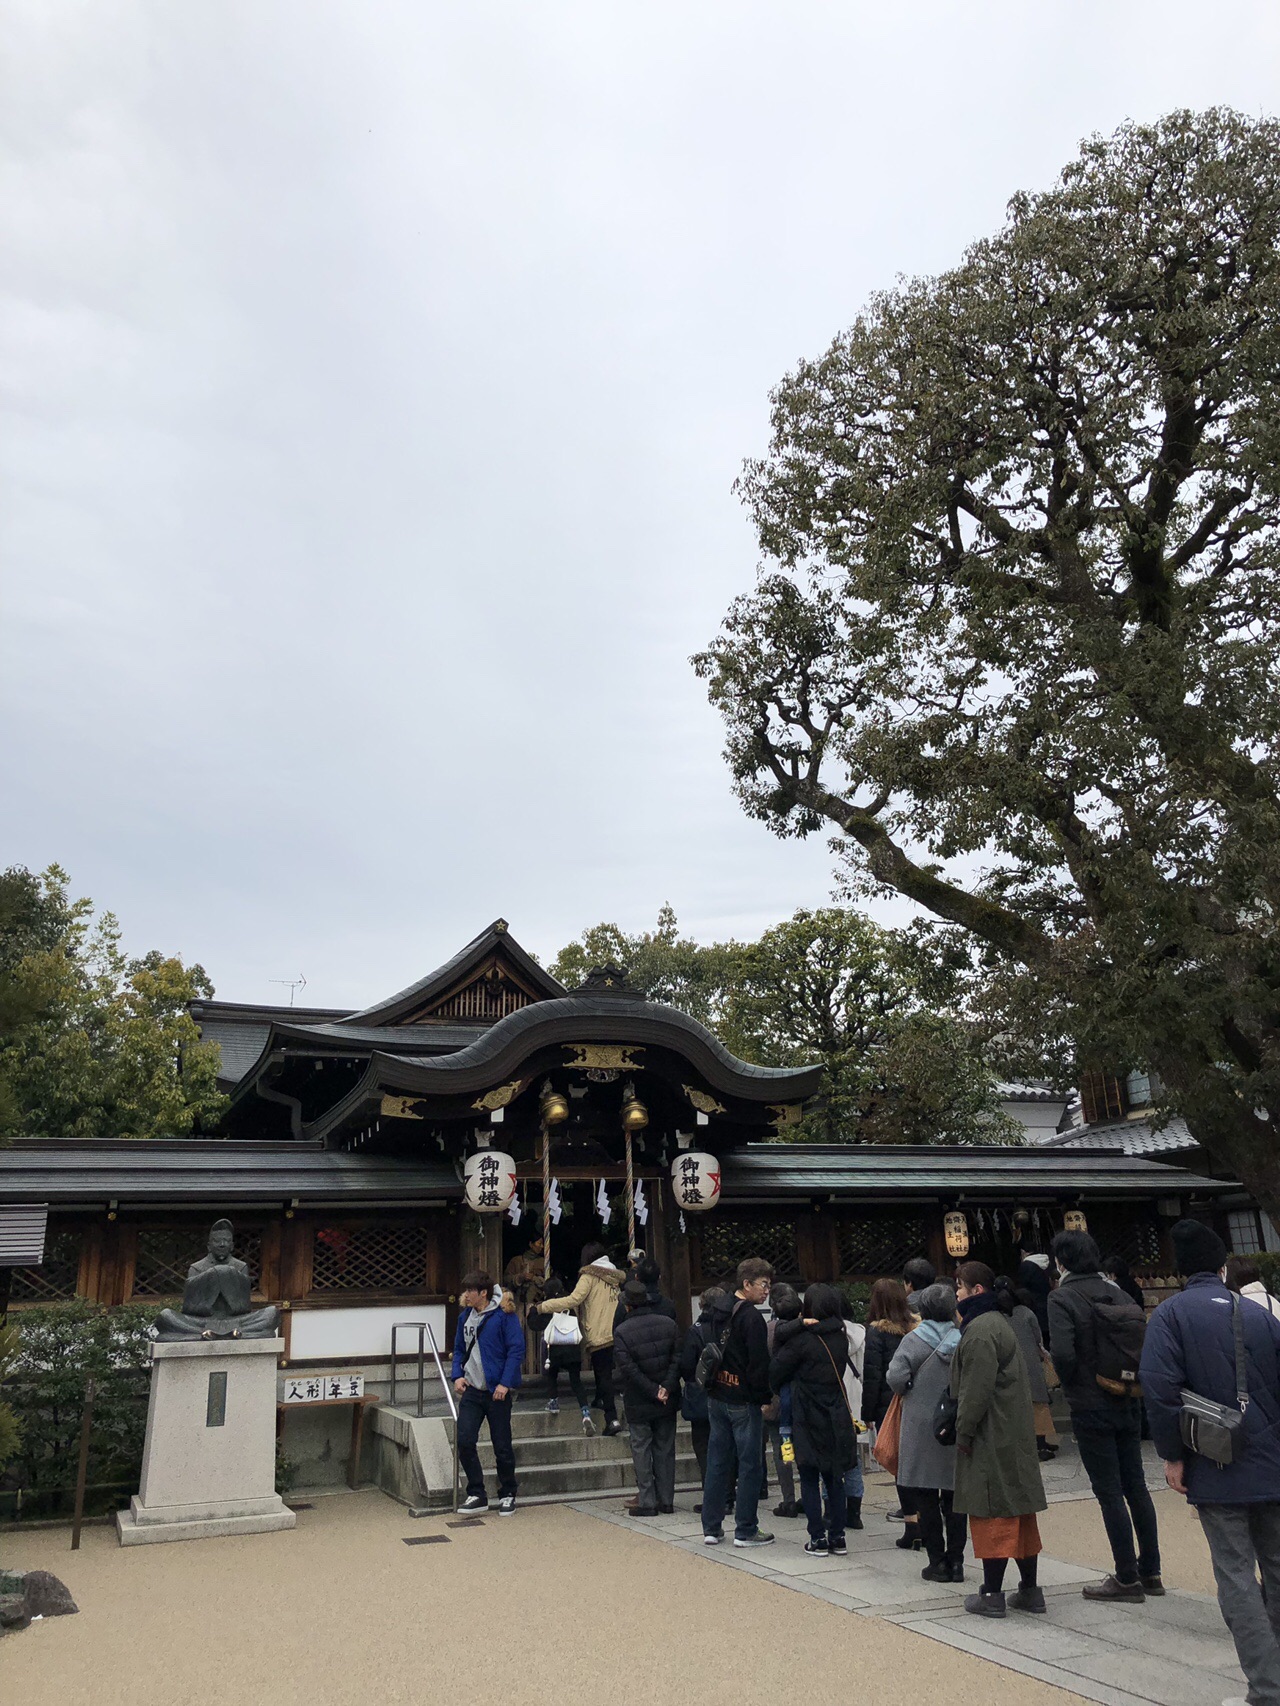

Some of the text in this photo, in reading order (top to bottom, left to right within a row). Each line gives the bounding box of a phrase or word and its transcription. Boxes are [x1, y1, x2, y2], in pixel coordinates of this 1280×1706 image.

[477, 1155, 501, 1207] 御神燈
[679, 1156, 704, 1205] 御神燈
[288, 1384, 320, 1399] 人形
[328, 1381, 360, 1398] 年豆
